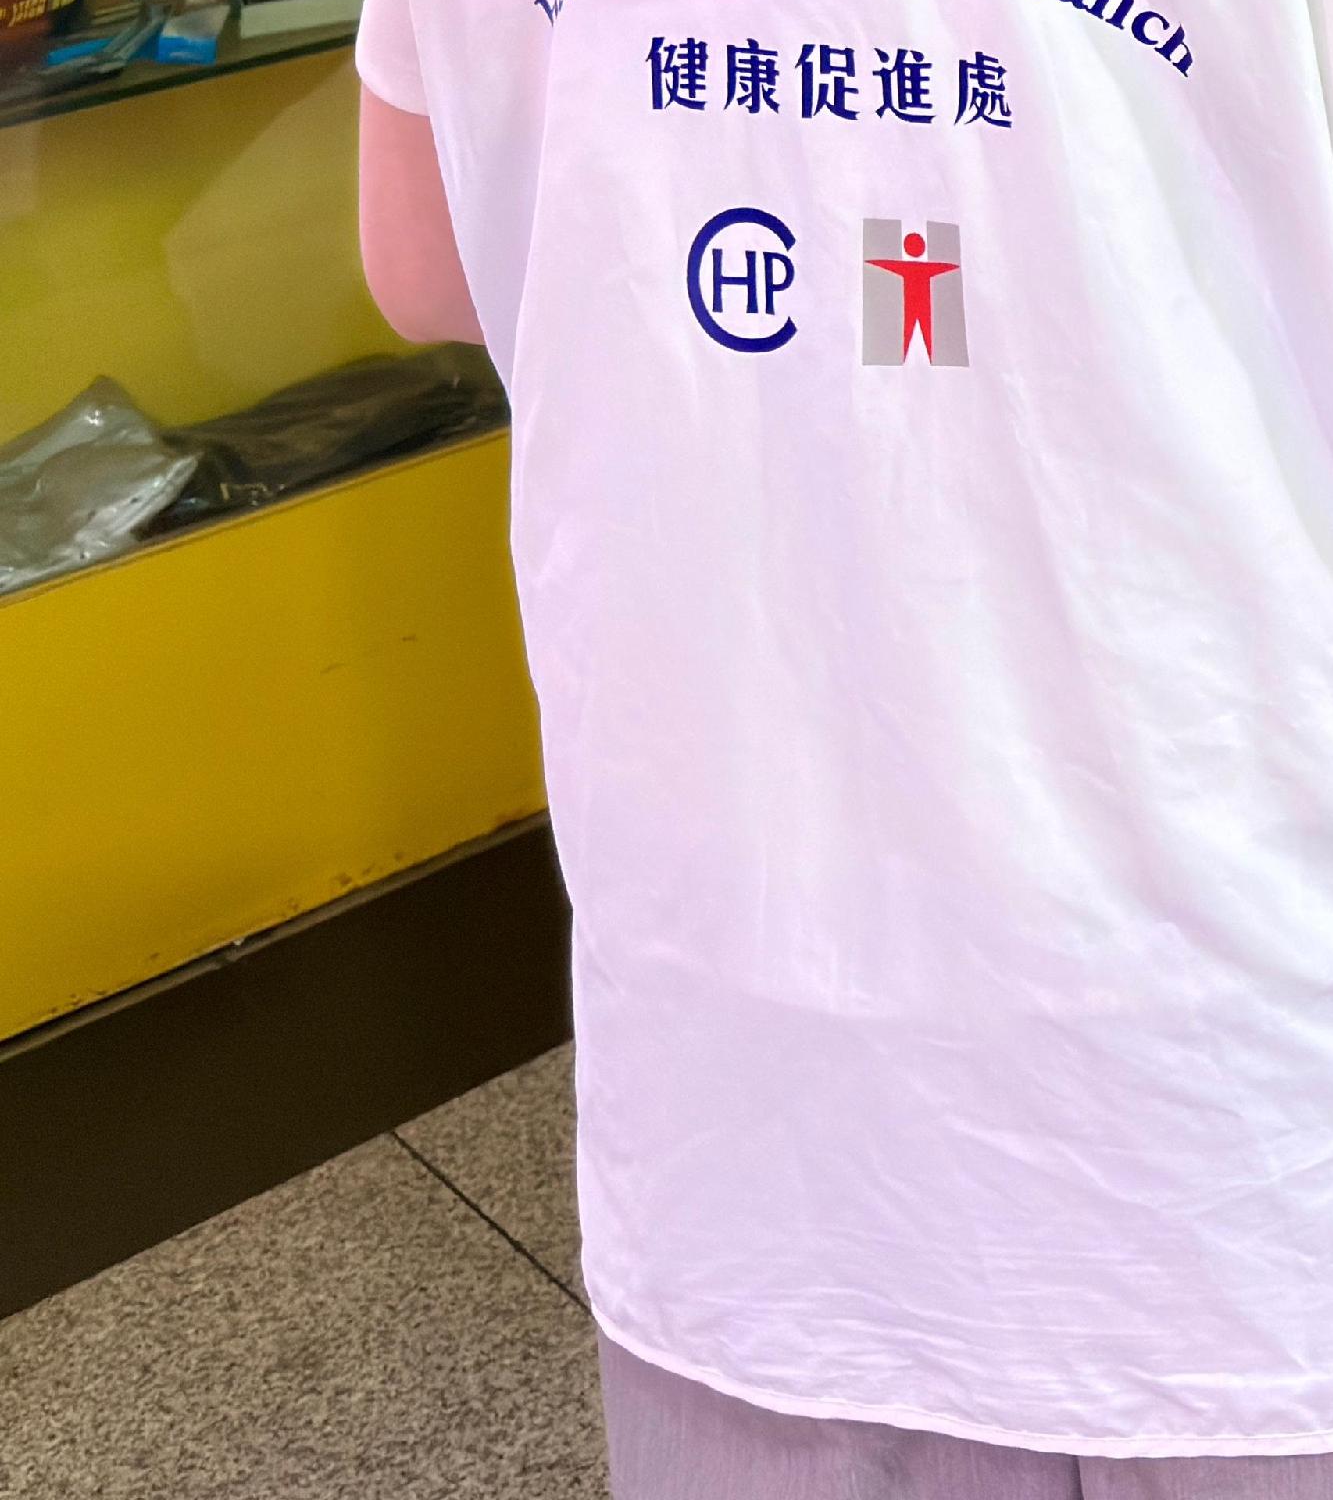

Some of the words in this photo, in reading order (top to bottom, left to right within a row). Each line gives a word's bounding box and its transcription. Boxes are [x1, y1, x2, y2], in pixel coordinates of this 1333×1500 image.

[645, 36, 1014, 129] 健康促進處
